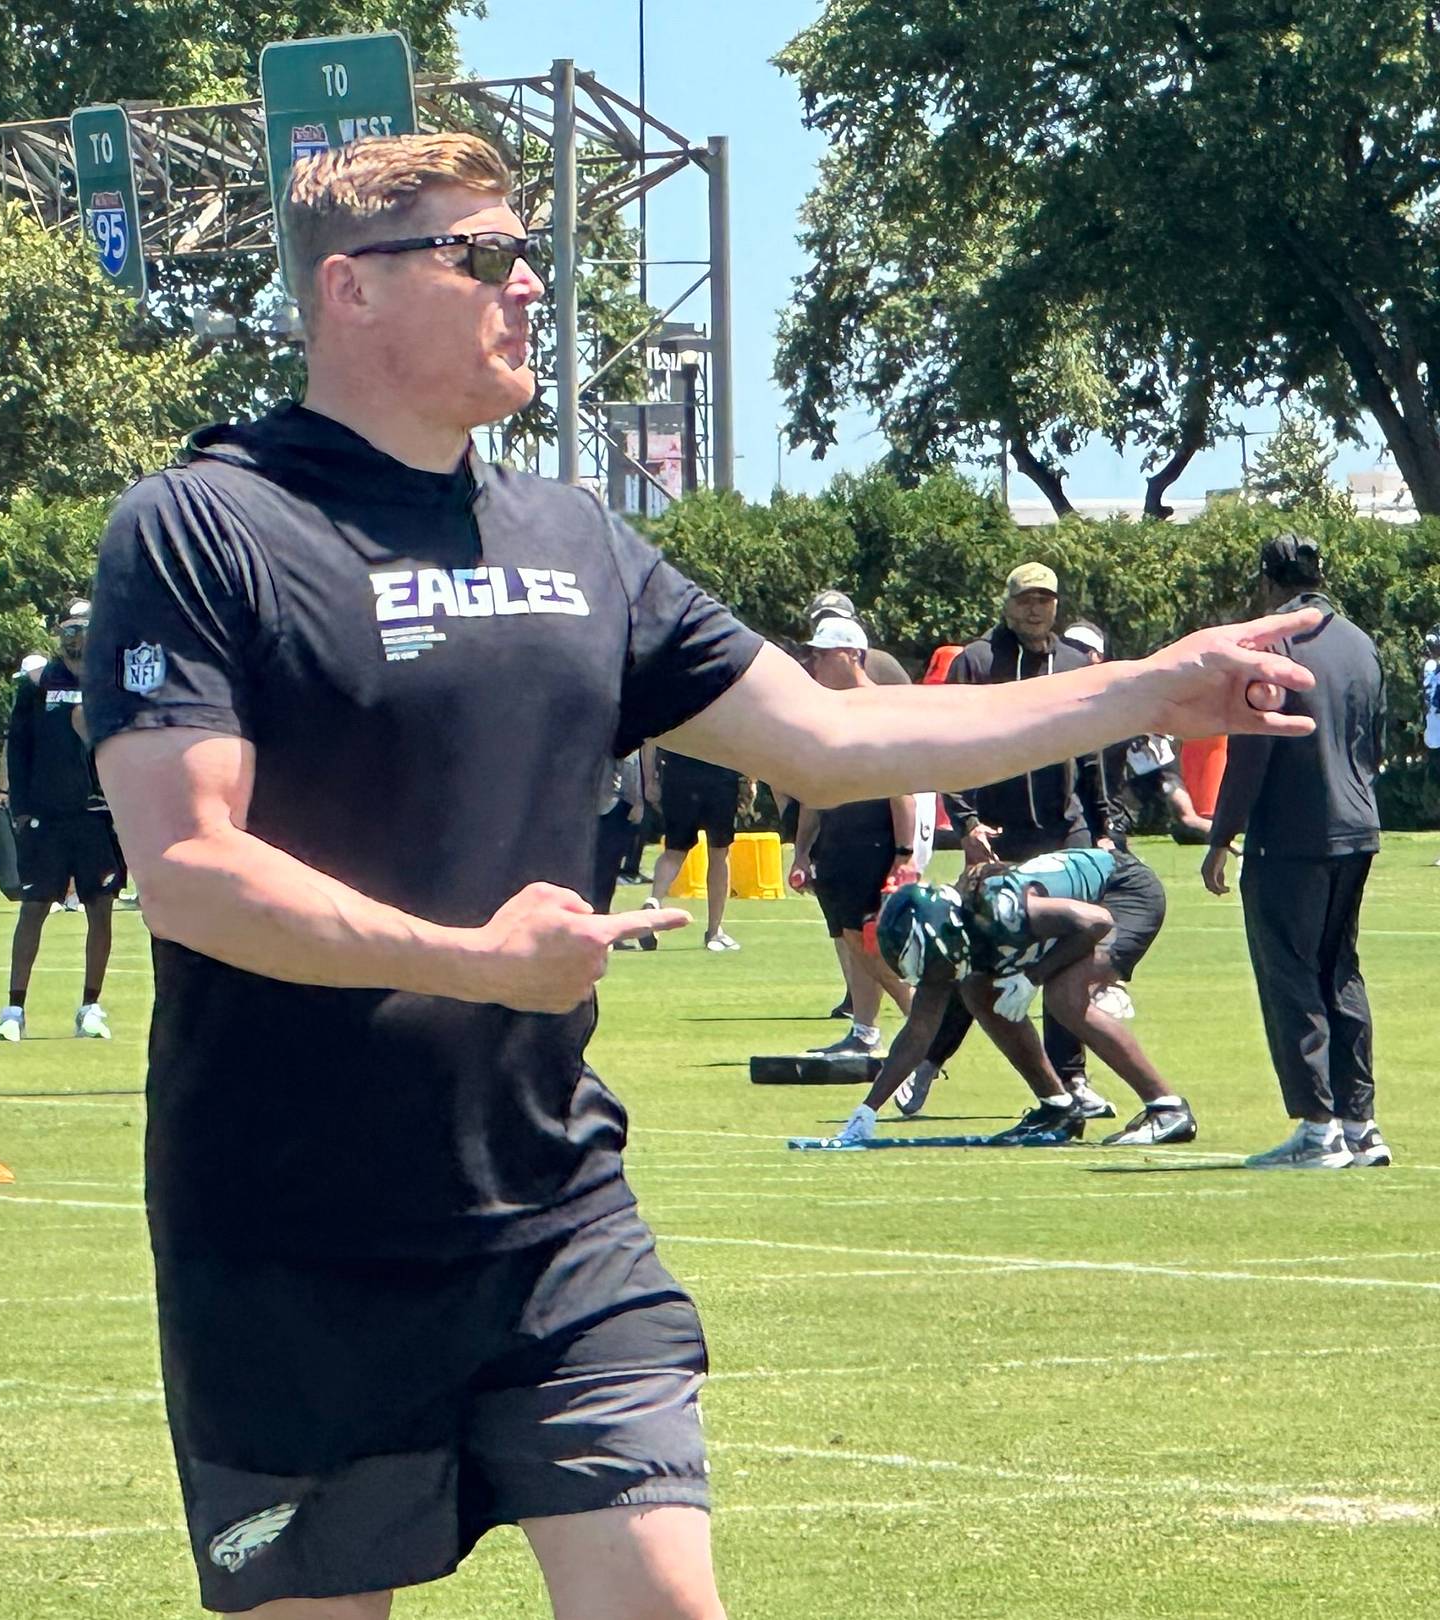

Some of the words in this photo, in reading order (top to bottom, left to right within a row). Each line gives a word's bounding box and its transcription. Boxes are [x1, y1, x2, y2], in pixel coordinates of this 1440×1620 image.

[321, 63, 349, 97] TO
[89, 132, 113, 165] TO
[96, 213, 125, 259] 95
[369, 566, 590, 621] EAGLES
[130, 665, 160, 686] NFL
